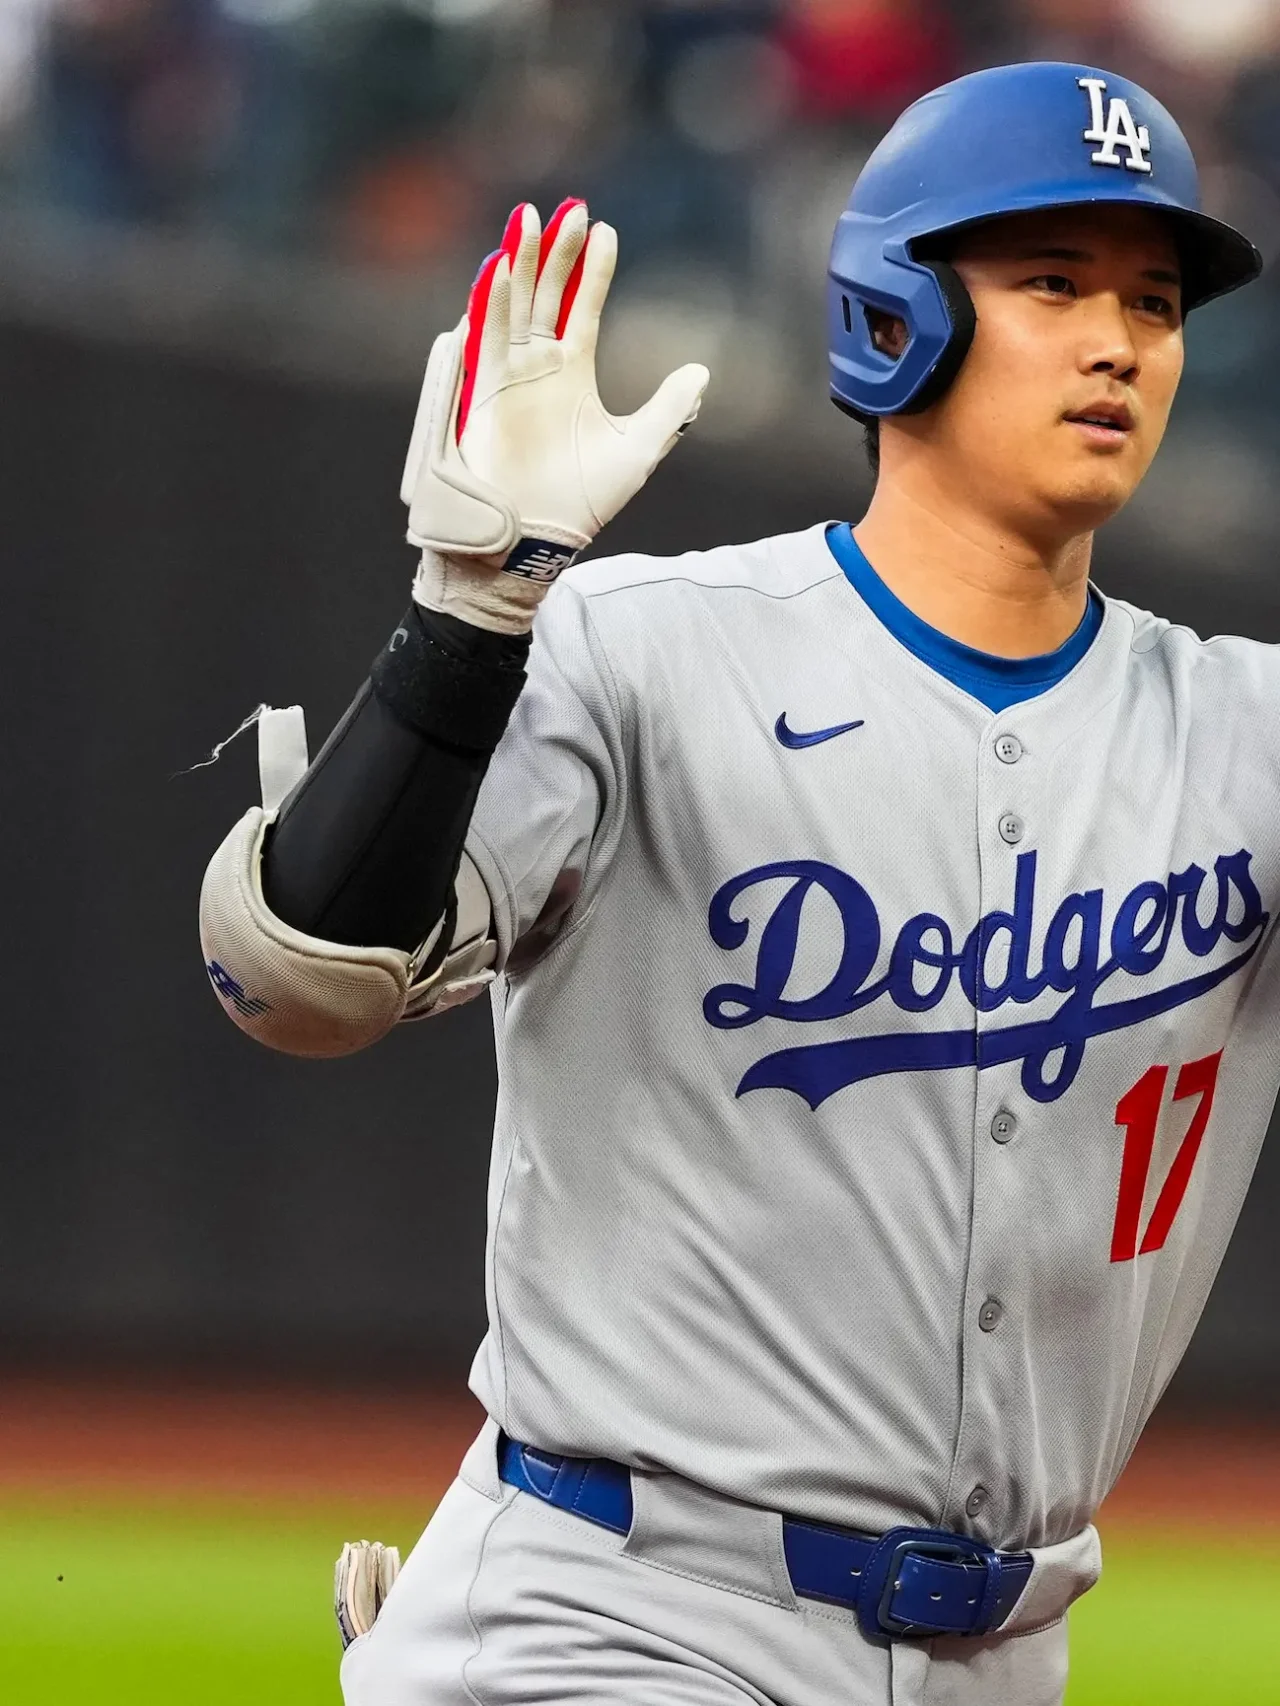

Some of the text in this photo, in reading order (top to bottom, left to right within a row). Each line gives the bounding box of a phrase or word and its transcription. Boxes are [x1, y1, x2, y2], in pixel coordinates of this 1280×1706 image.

[1078, 78, 1151, 172] LA
[702, 848, 1270, 1105] Dodgers
[1110, 1046, 1224, 1263] 17
